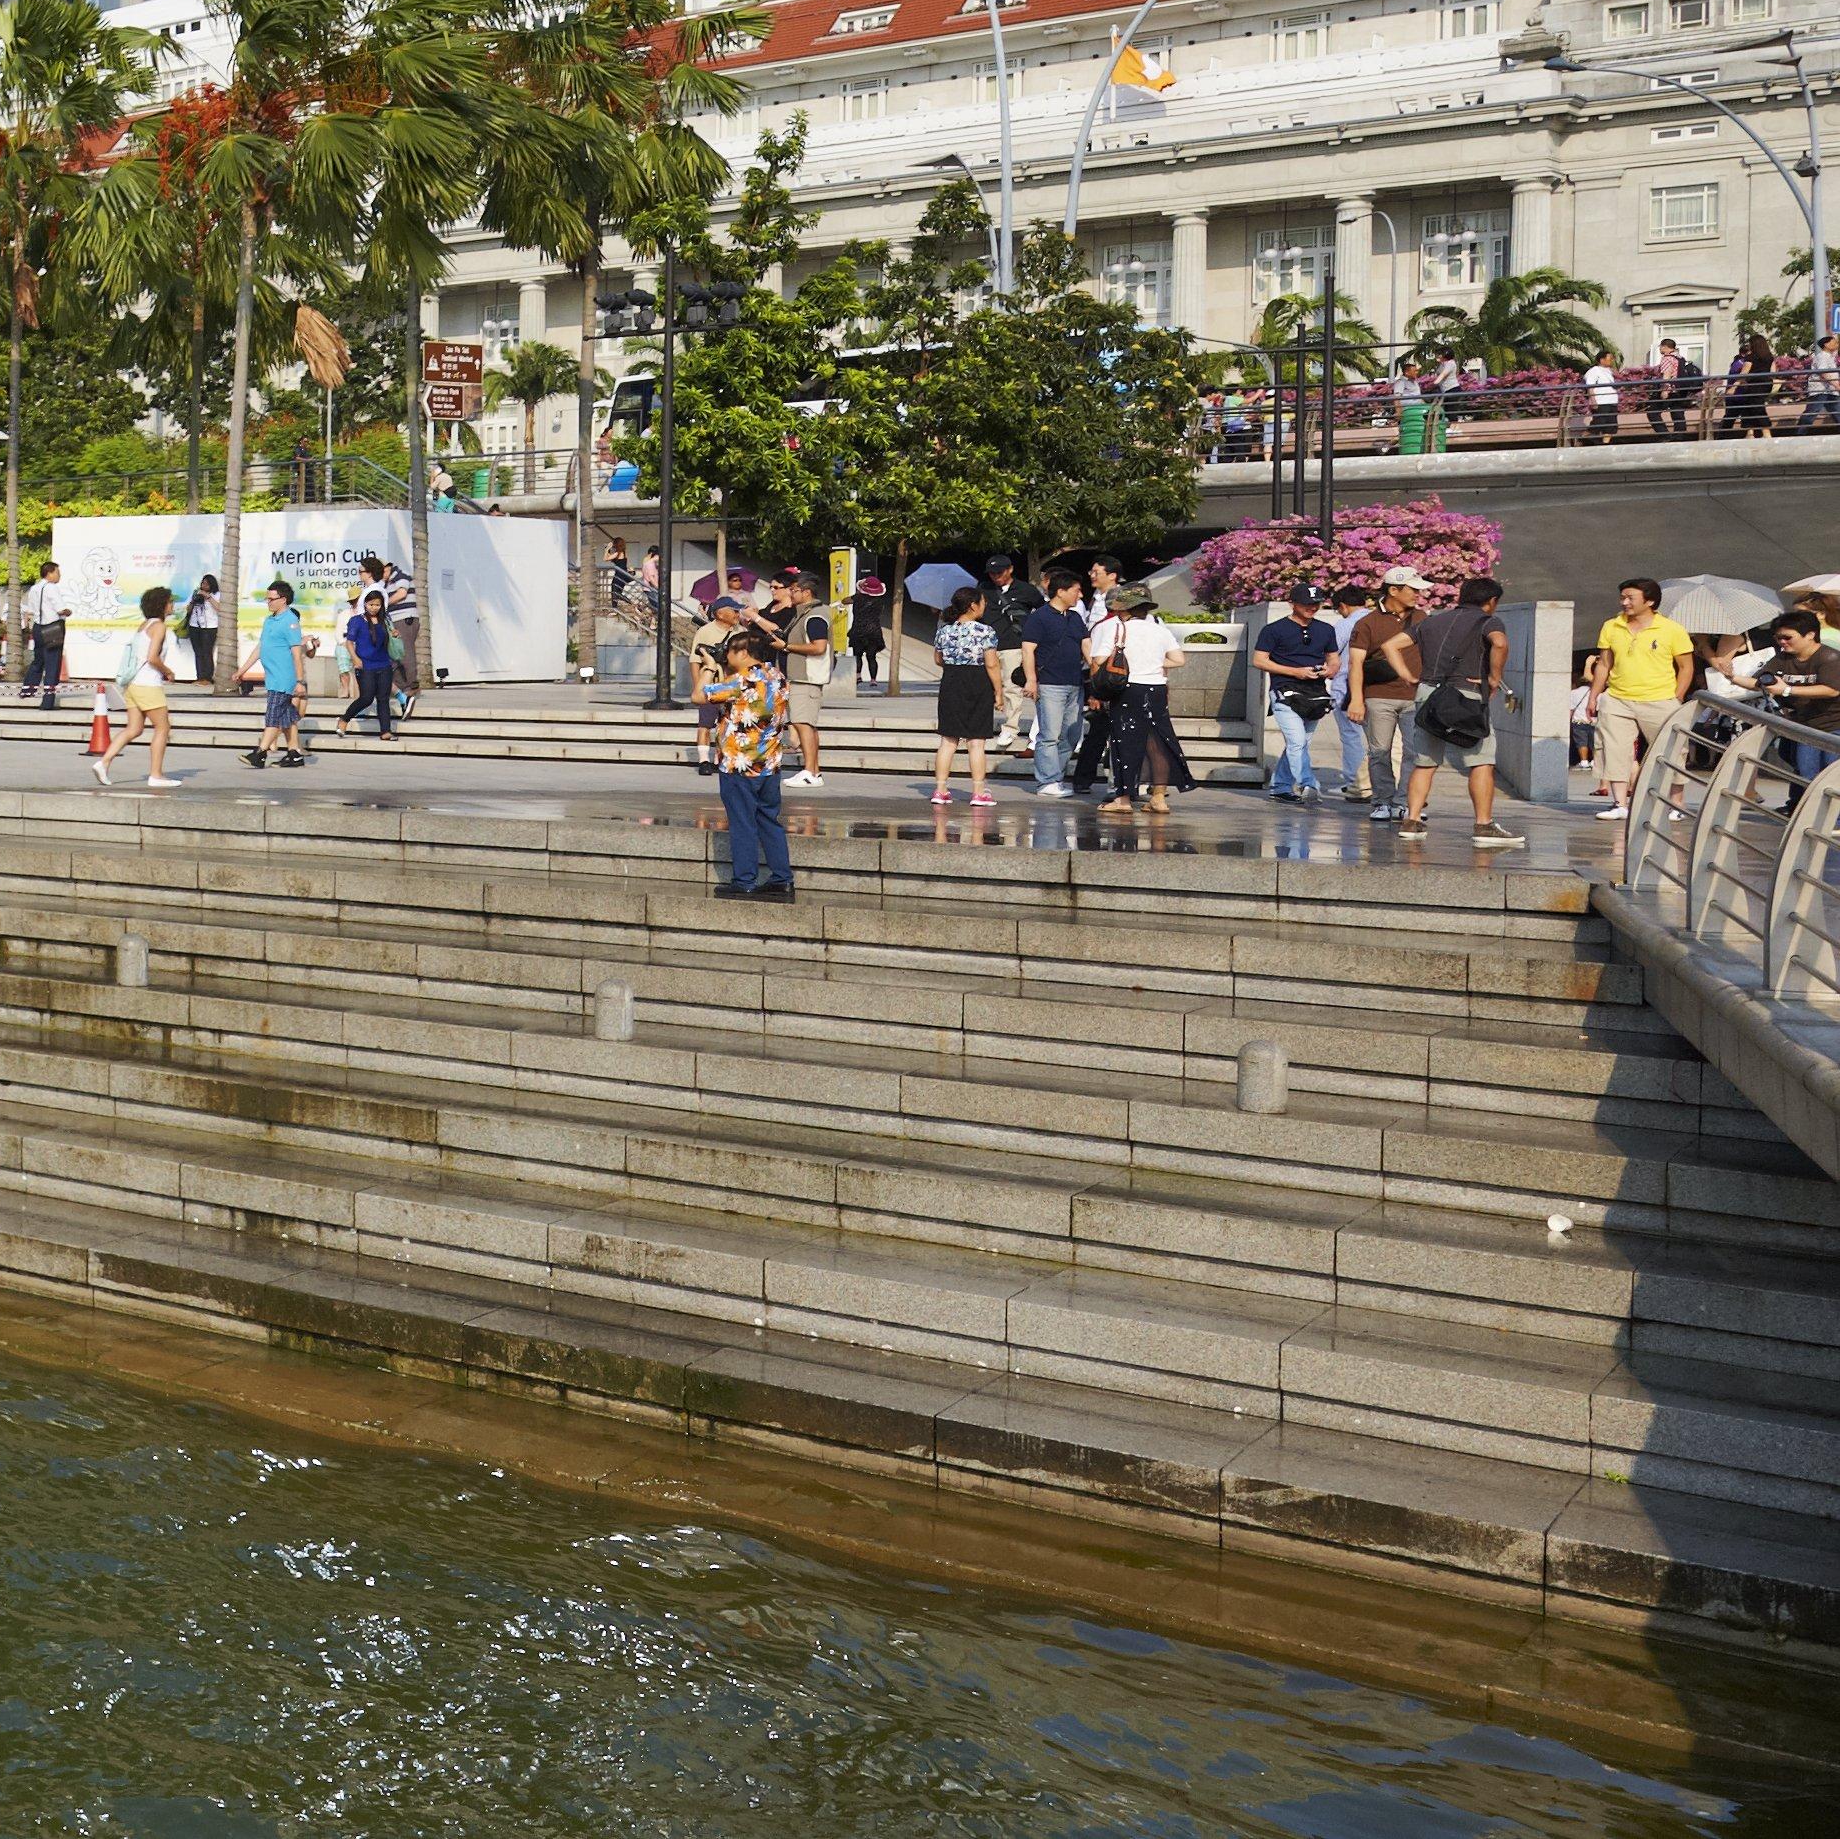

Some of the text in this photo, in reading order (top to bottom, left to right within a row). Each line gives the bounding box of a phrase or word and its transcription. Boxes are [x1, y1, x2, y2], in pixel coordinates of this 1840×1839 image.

[271, 550, 336, 564] Merlion
[296, 567, 359, 578] is undergo
[300, 581, 306, 590] a
